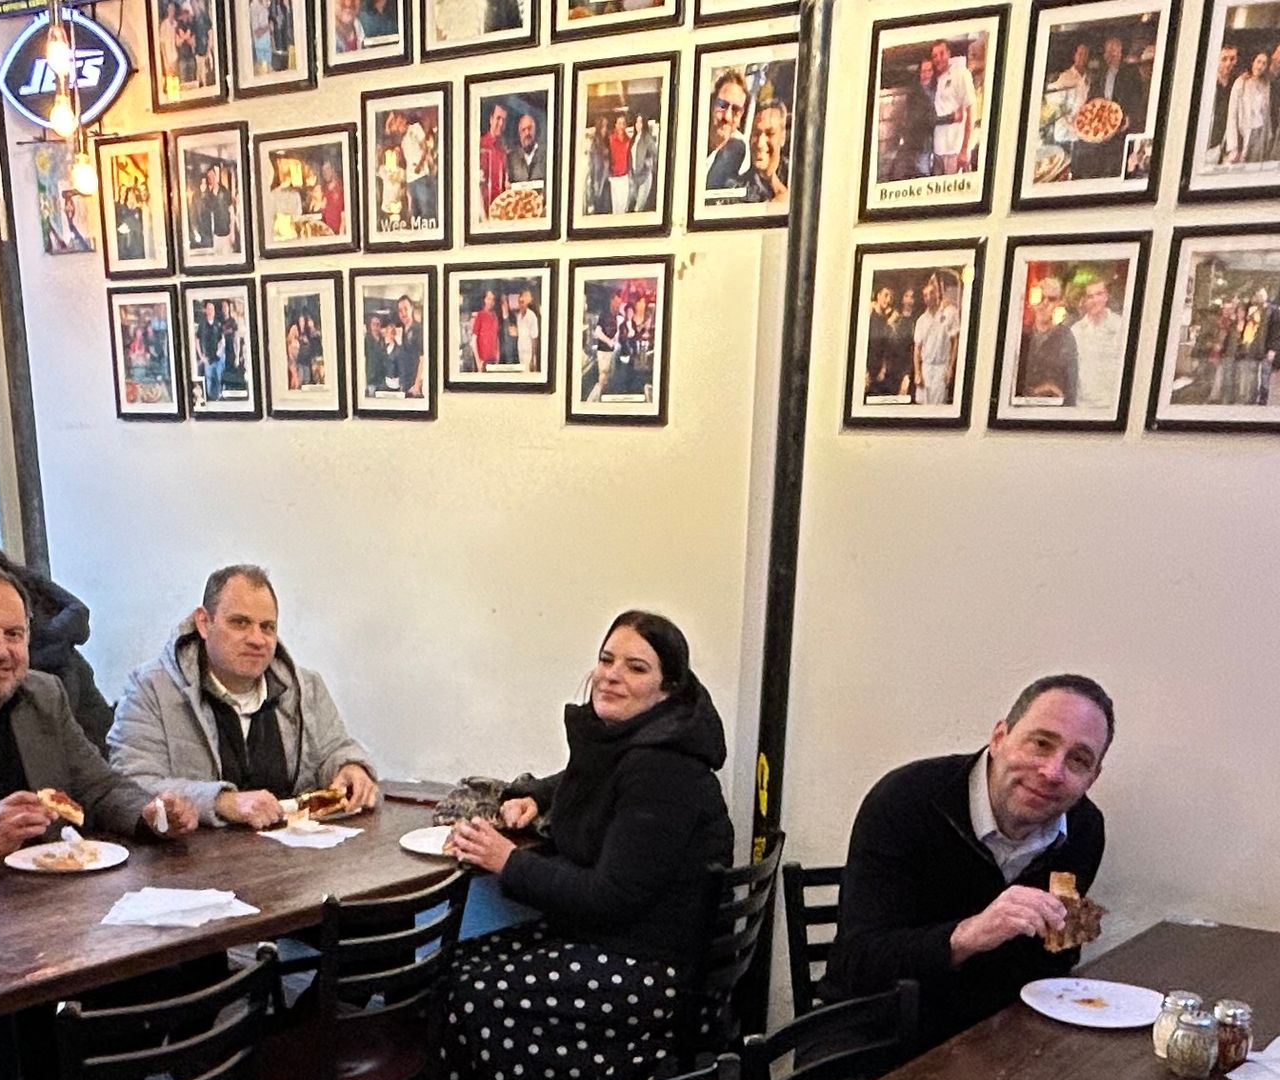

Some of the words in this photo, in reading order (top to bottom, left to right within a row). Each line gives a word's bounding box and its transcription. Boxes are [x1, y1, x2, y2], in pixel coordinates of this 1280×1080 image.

[879, 184, 922, 201] Brooke
[926, 178, 972, 195] Shields
[381, 219, 407, 232] Wee
[411, 216, 437, 230] Man
